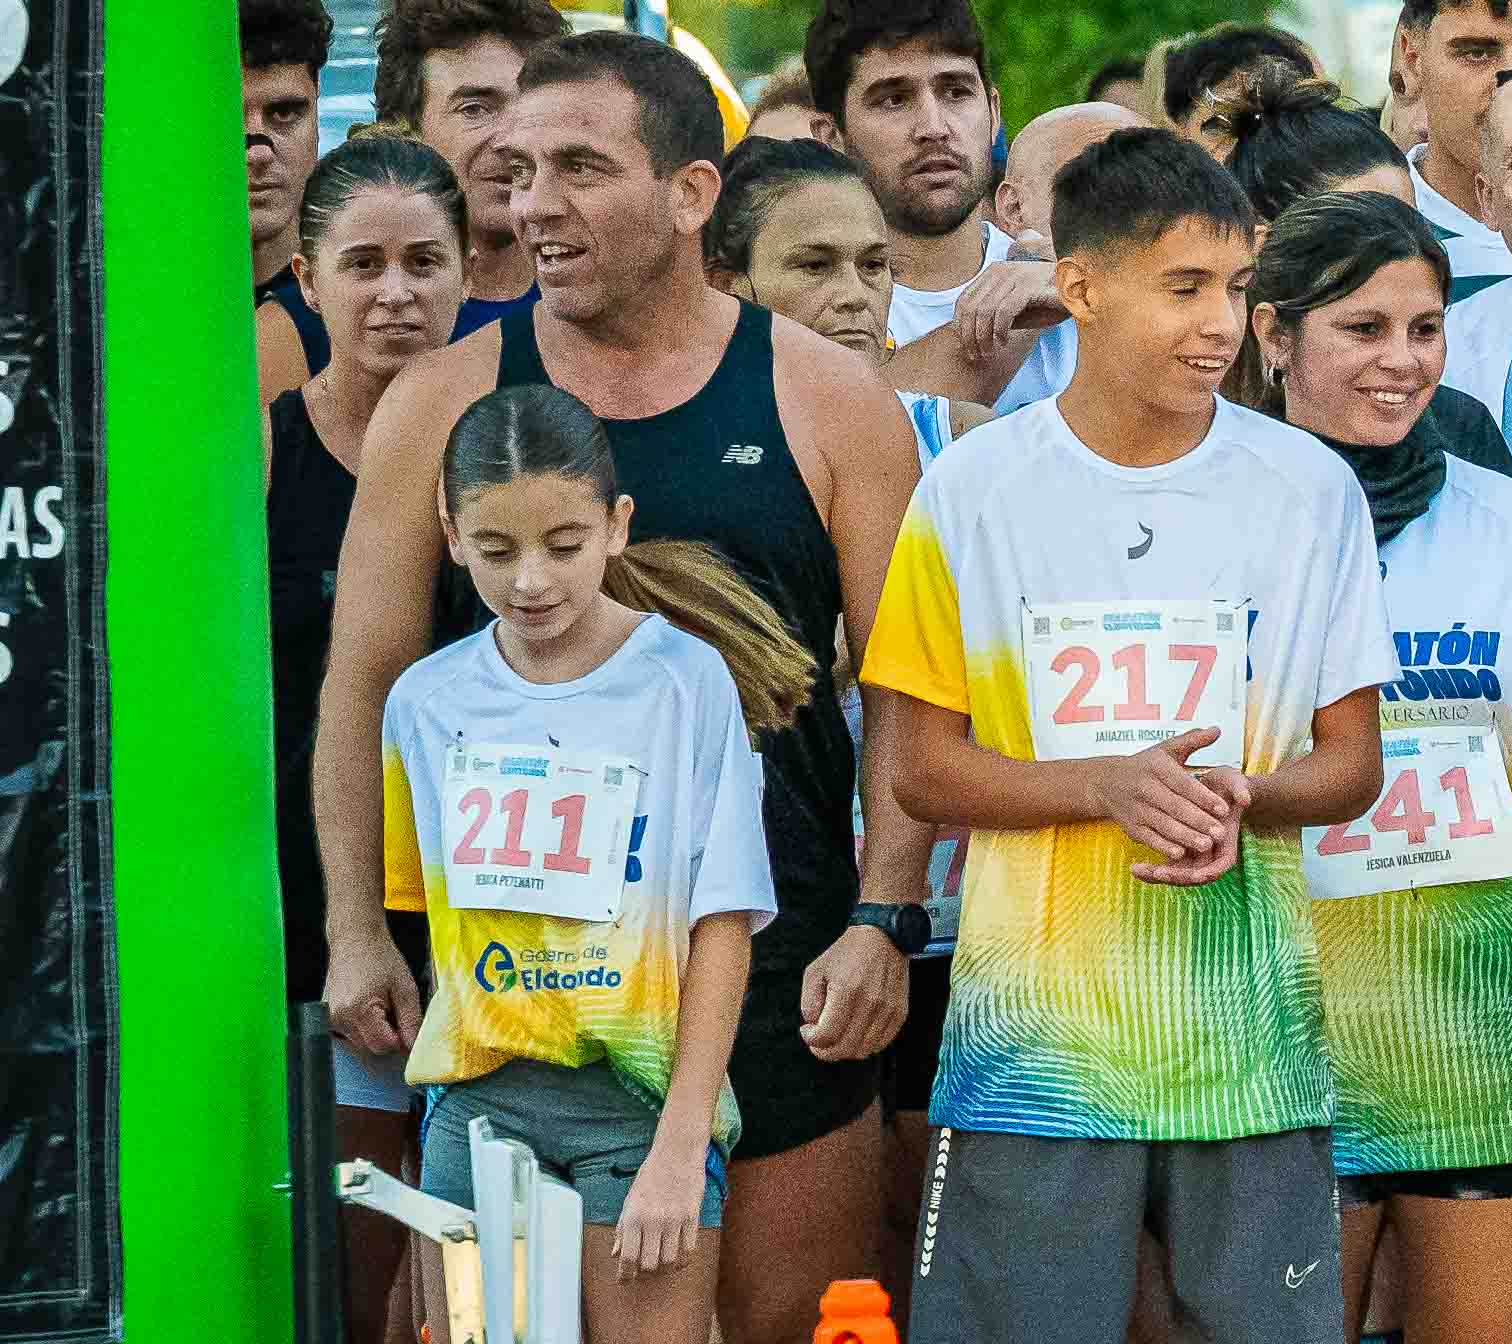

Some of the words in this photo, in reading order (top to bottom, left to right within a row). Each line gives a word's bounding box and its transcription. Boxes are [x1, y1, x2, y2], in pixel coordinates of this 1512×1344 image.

[1049, 643, 1218, 726] 217
[453, 787, 592, 875] 211
[1366, 856, 1395, 871] JESICA
[1396, 849, 1452, 867] VALENZUELA
